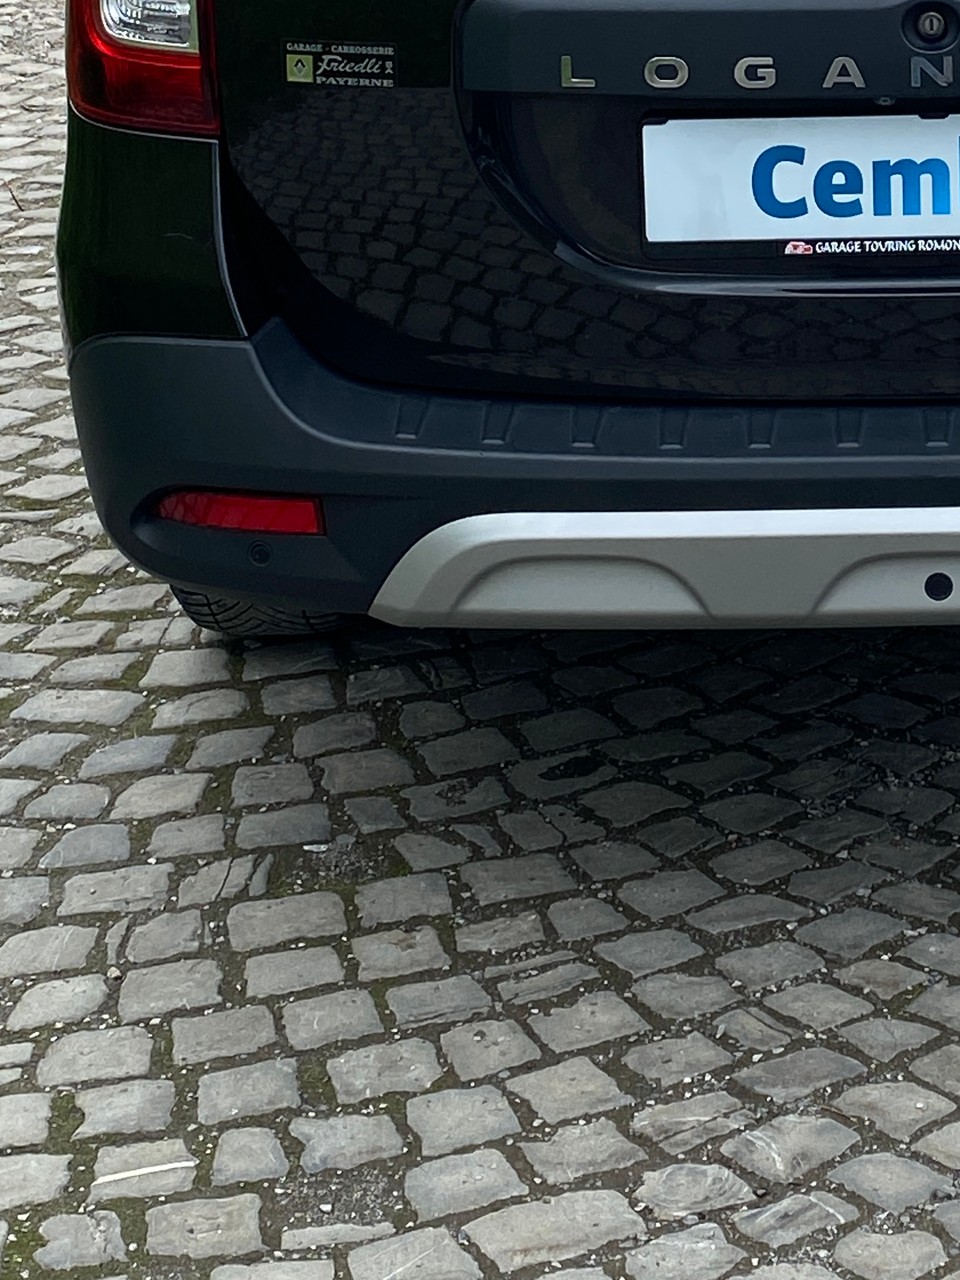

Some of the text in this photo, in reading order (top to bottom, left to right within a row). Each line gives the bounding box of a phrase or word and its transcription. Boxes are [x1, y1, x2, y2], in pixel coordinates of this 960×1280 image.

[286, 42, 323, 52] GARAGE
[331, 45, 395, 55] CARROSSERIE
[315, 55, 382, 75] Friedli
[560, 55, 953, 88] LOGAN
[316, 76, 394, 88] PAYERNE
[815, 241, 862, 254] GARAGE
[863, 240, 916, 253] TOURING
